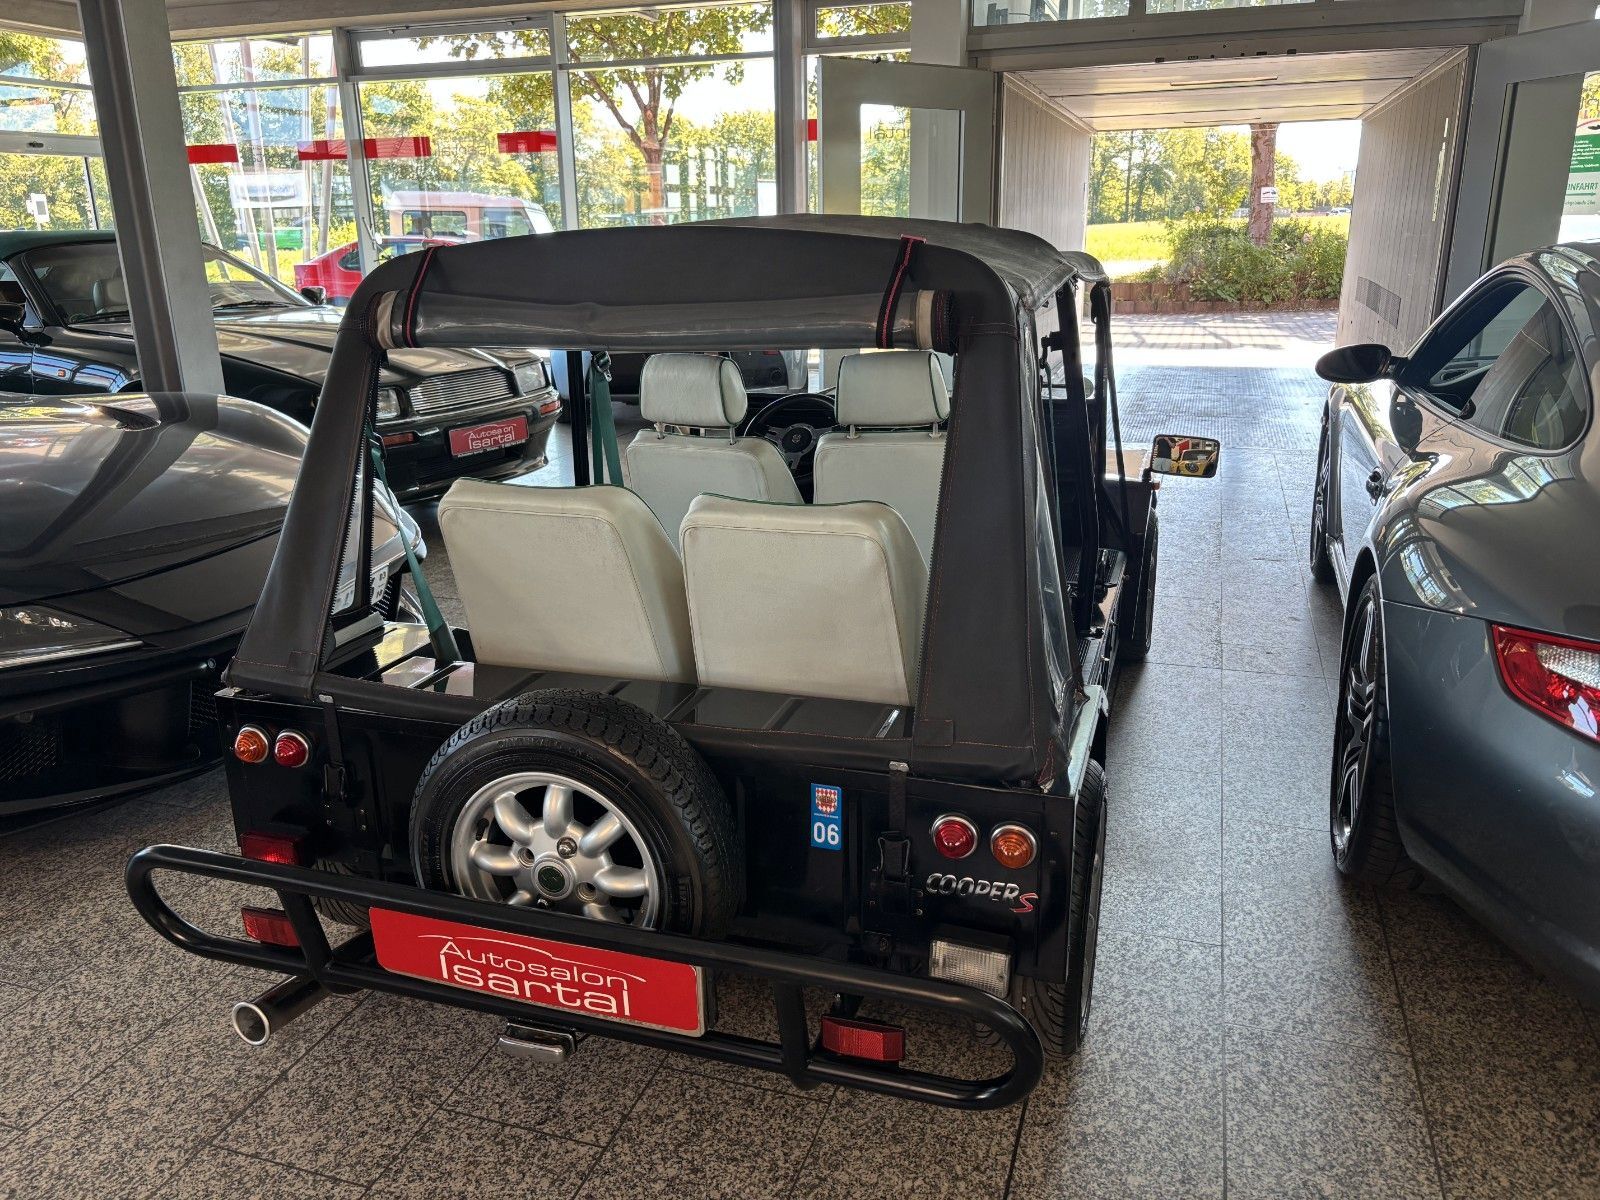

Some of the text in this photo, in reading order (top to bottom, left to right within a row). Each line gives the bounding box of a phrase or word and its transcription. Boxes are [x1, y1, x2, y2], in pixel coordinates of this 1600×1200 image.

[1567, 183, 1598, 191] INFAHRT
[468, 431, 515, 450] Isartal
[469, 426, 514, 439] Autosaon
[813, 821, 839, 845] 06
[925, 872, 1020, 903] COOPER
[439, 941, 628, 991] Autosalon
[439, 953, 630, 1016] Isartal
